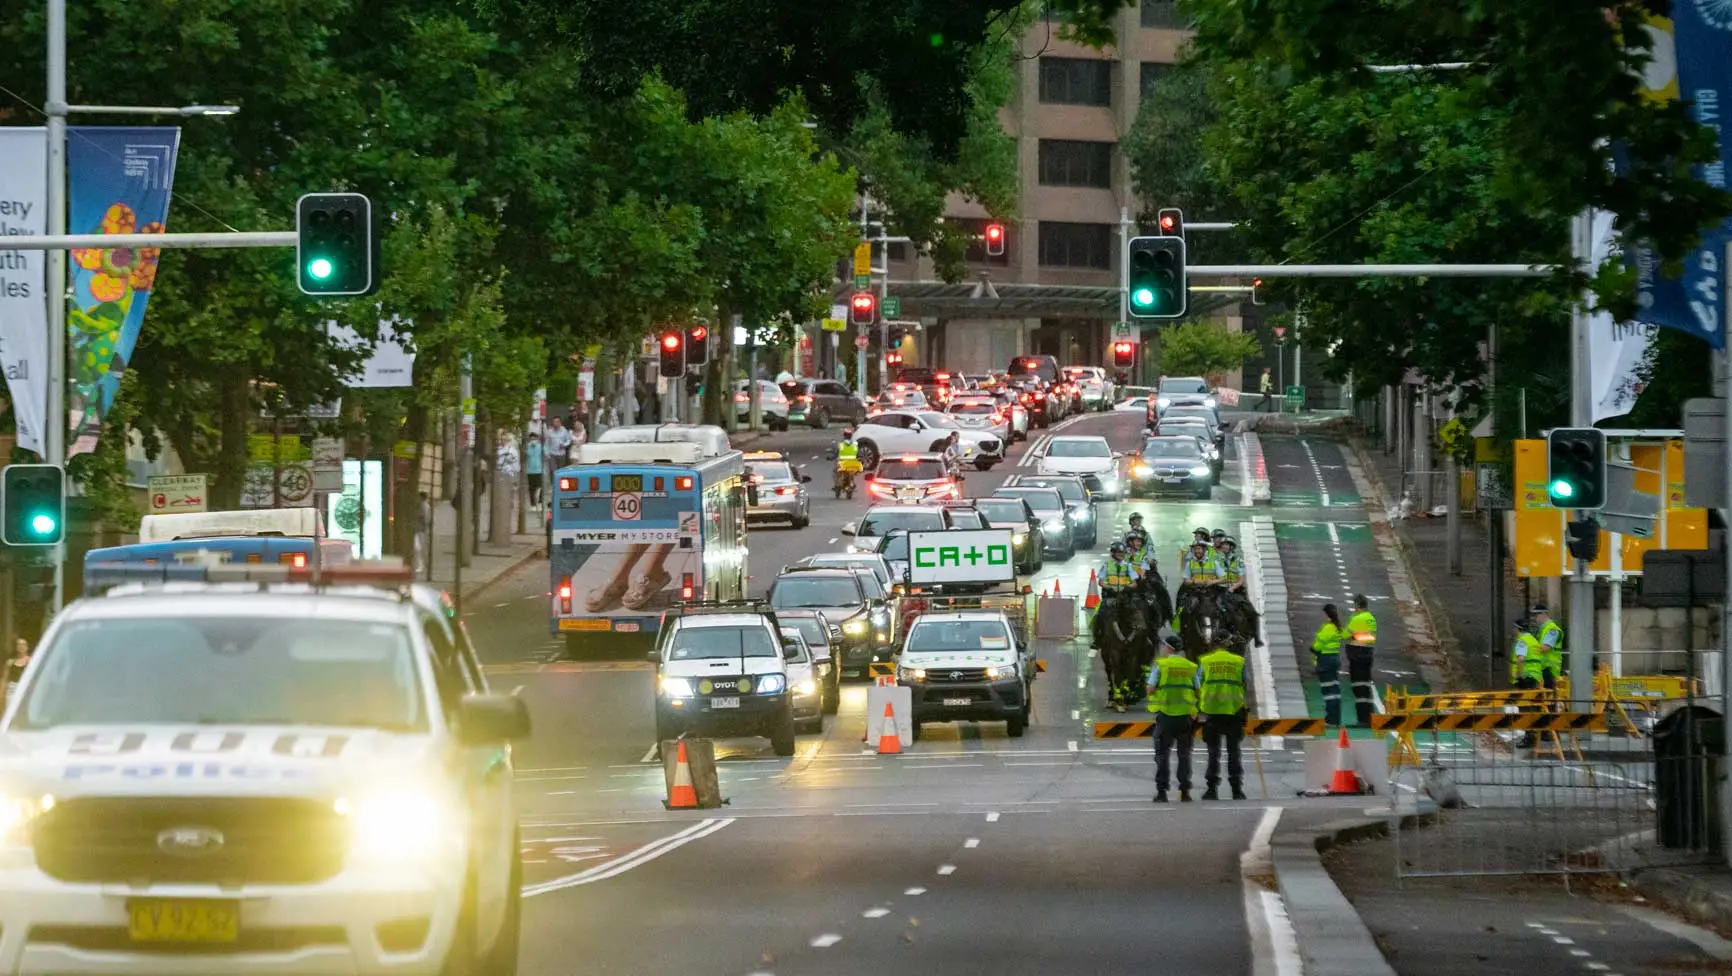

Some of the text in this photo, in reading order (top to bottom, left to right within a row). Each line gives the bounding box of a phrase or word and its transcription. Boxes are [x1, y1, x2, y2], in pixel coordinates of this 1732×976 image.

[8, 359, 29, 380] all
[617, 499, 638, 513] 40
[576, 532, 680, 541] MYER MY STORE
